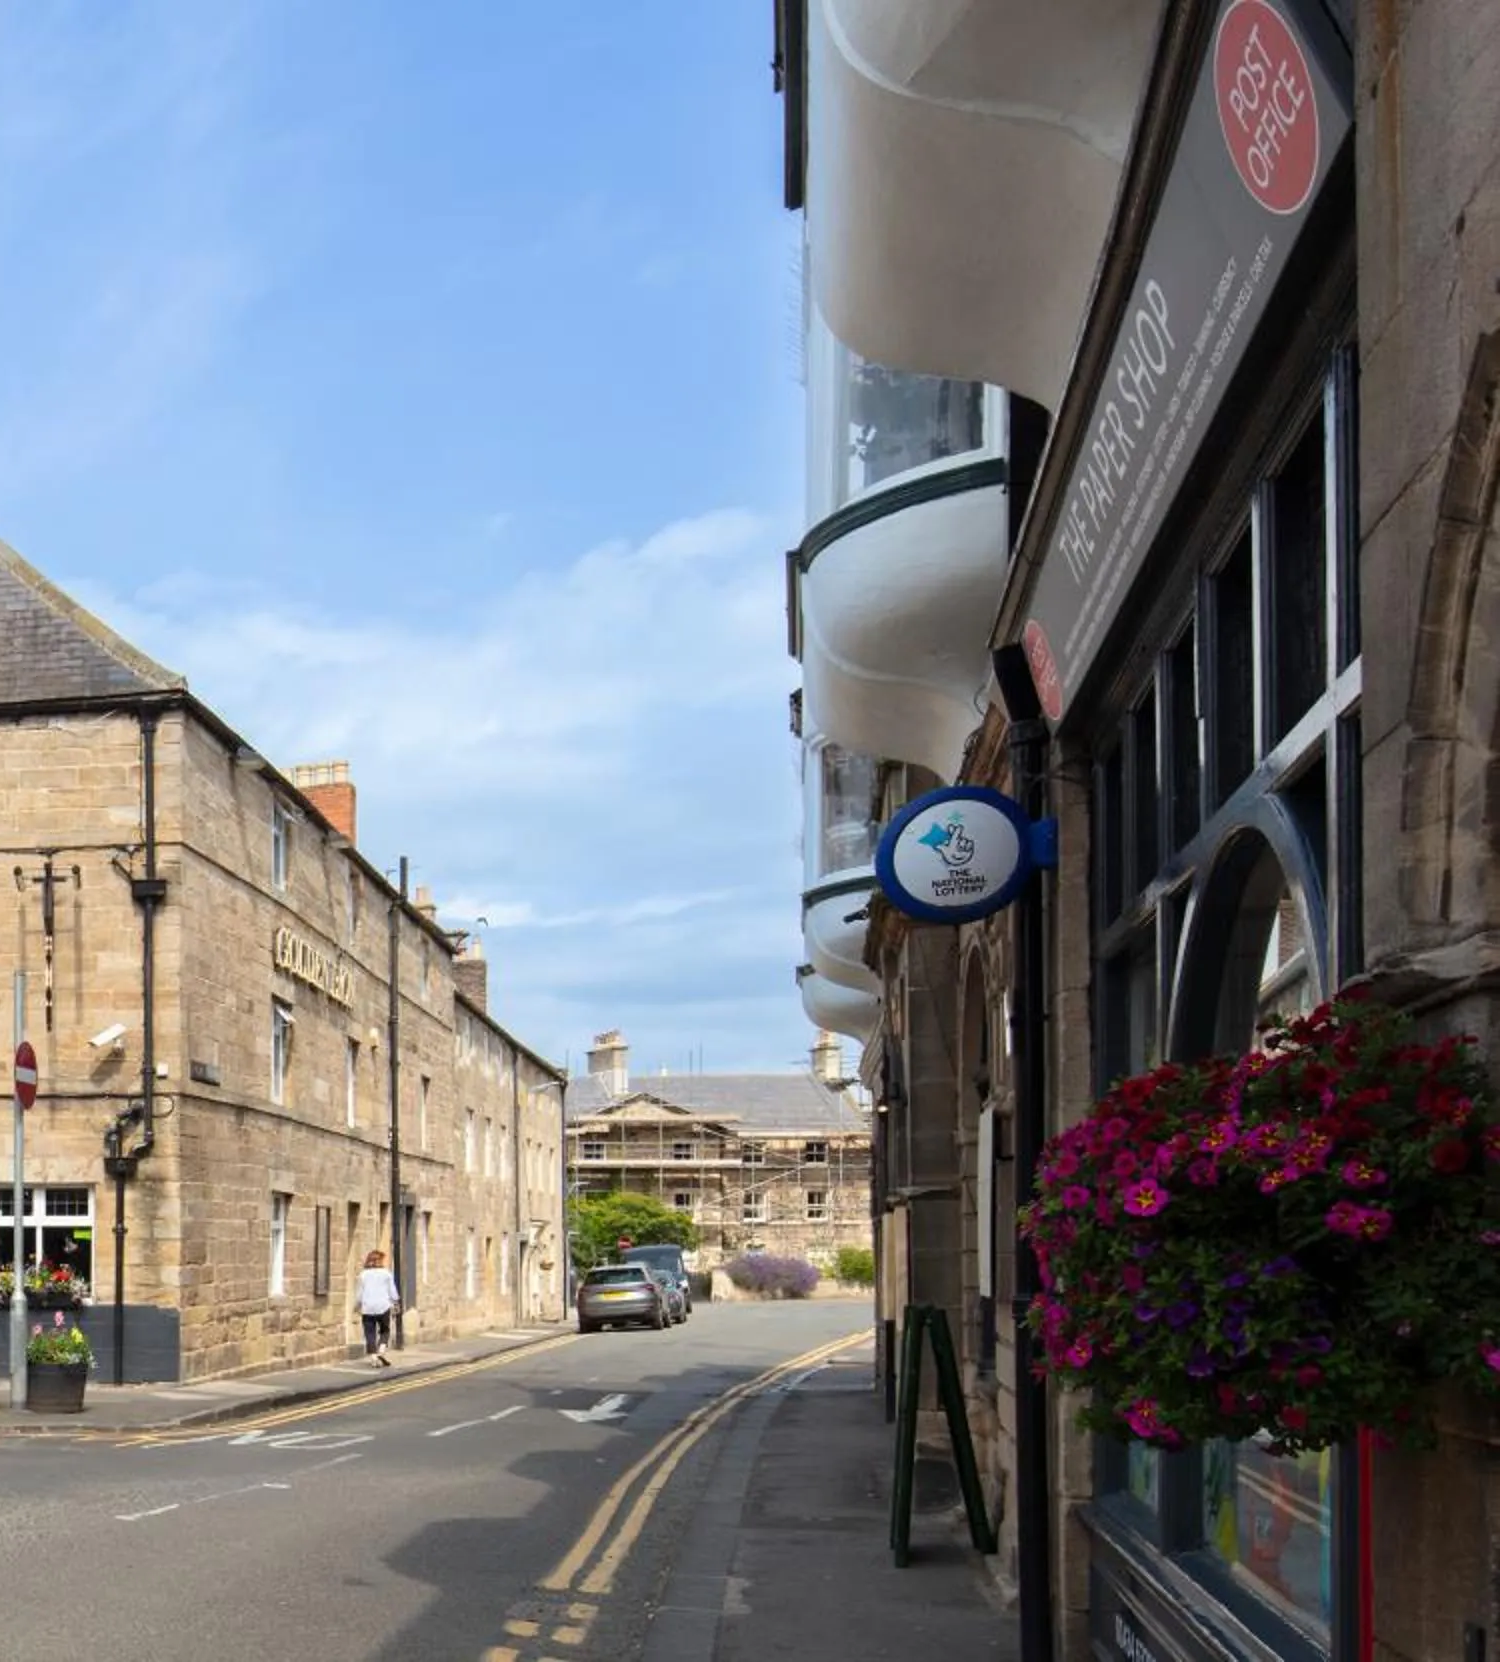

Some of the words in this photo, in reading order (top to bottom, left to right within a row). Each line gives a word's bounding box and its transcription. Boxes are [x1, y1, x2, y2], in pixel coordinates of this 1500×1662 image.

[1230, 23, 1272, 133] POST
[1247, 59, 1304, 188] OFFICE
[1059, 500, 1095, 585] THE
[1080, 402, 1136, 532] PAPER
[1117, 279, 1176, 430] SHOP
[948, 869, 972, 878] THE
